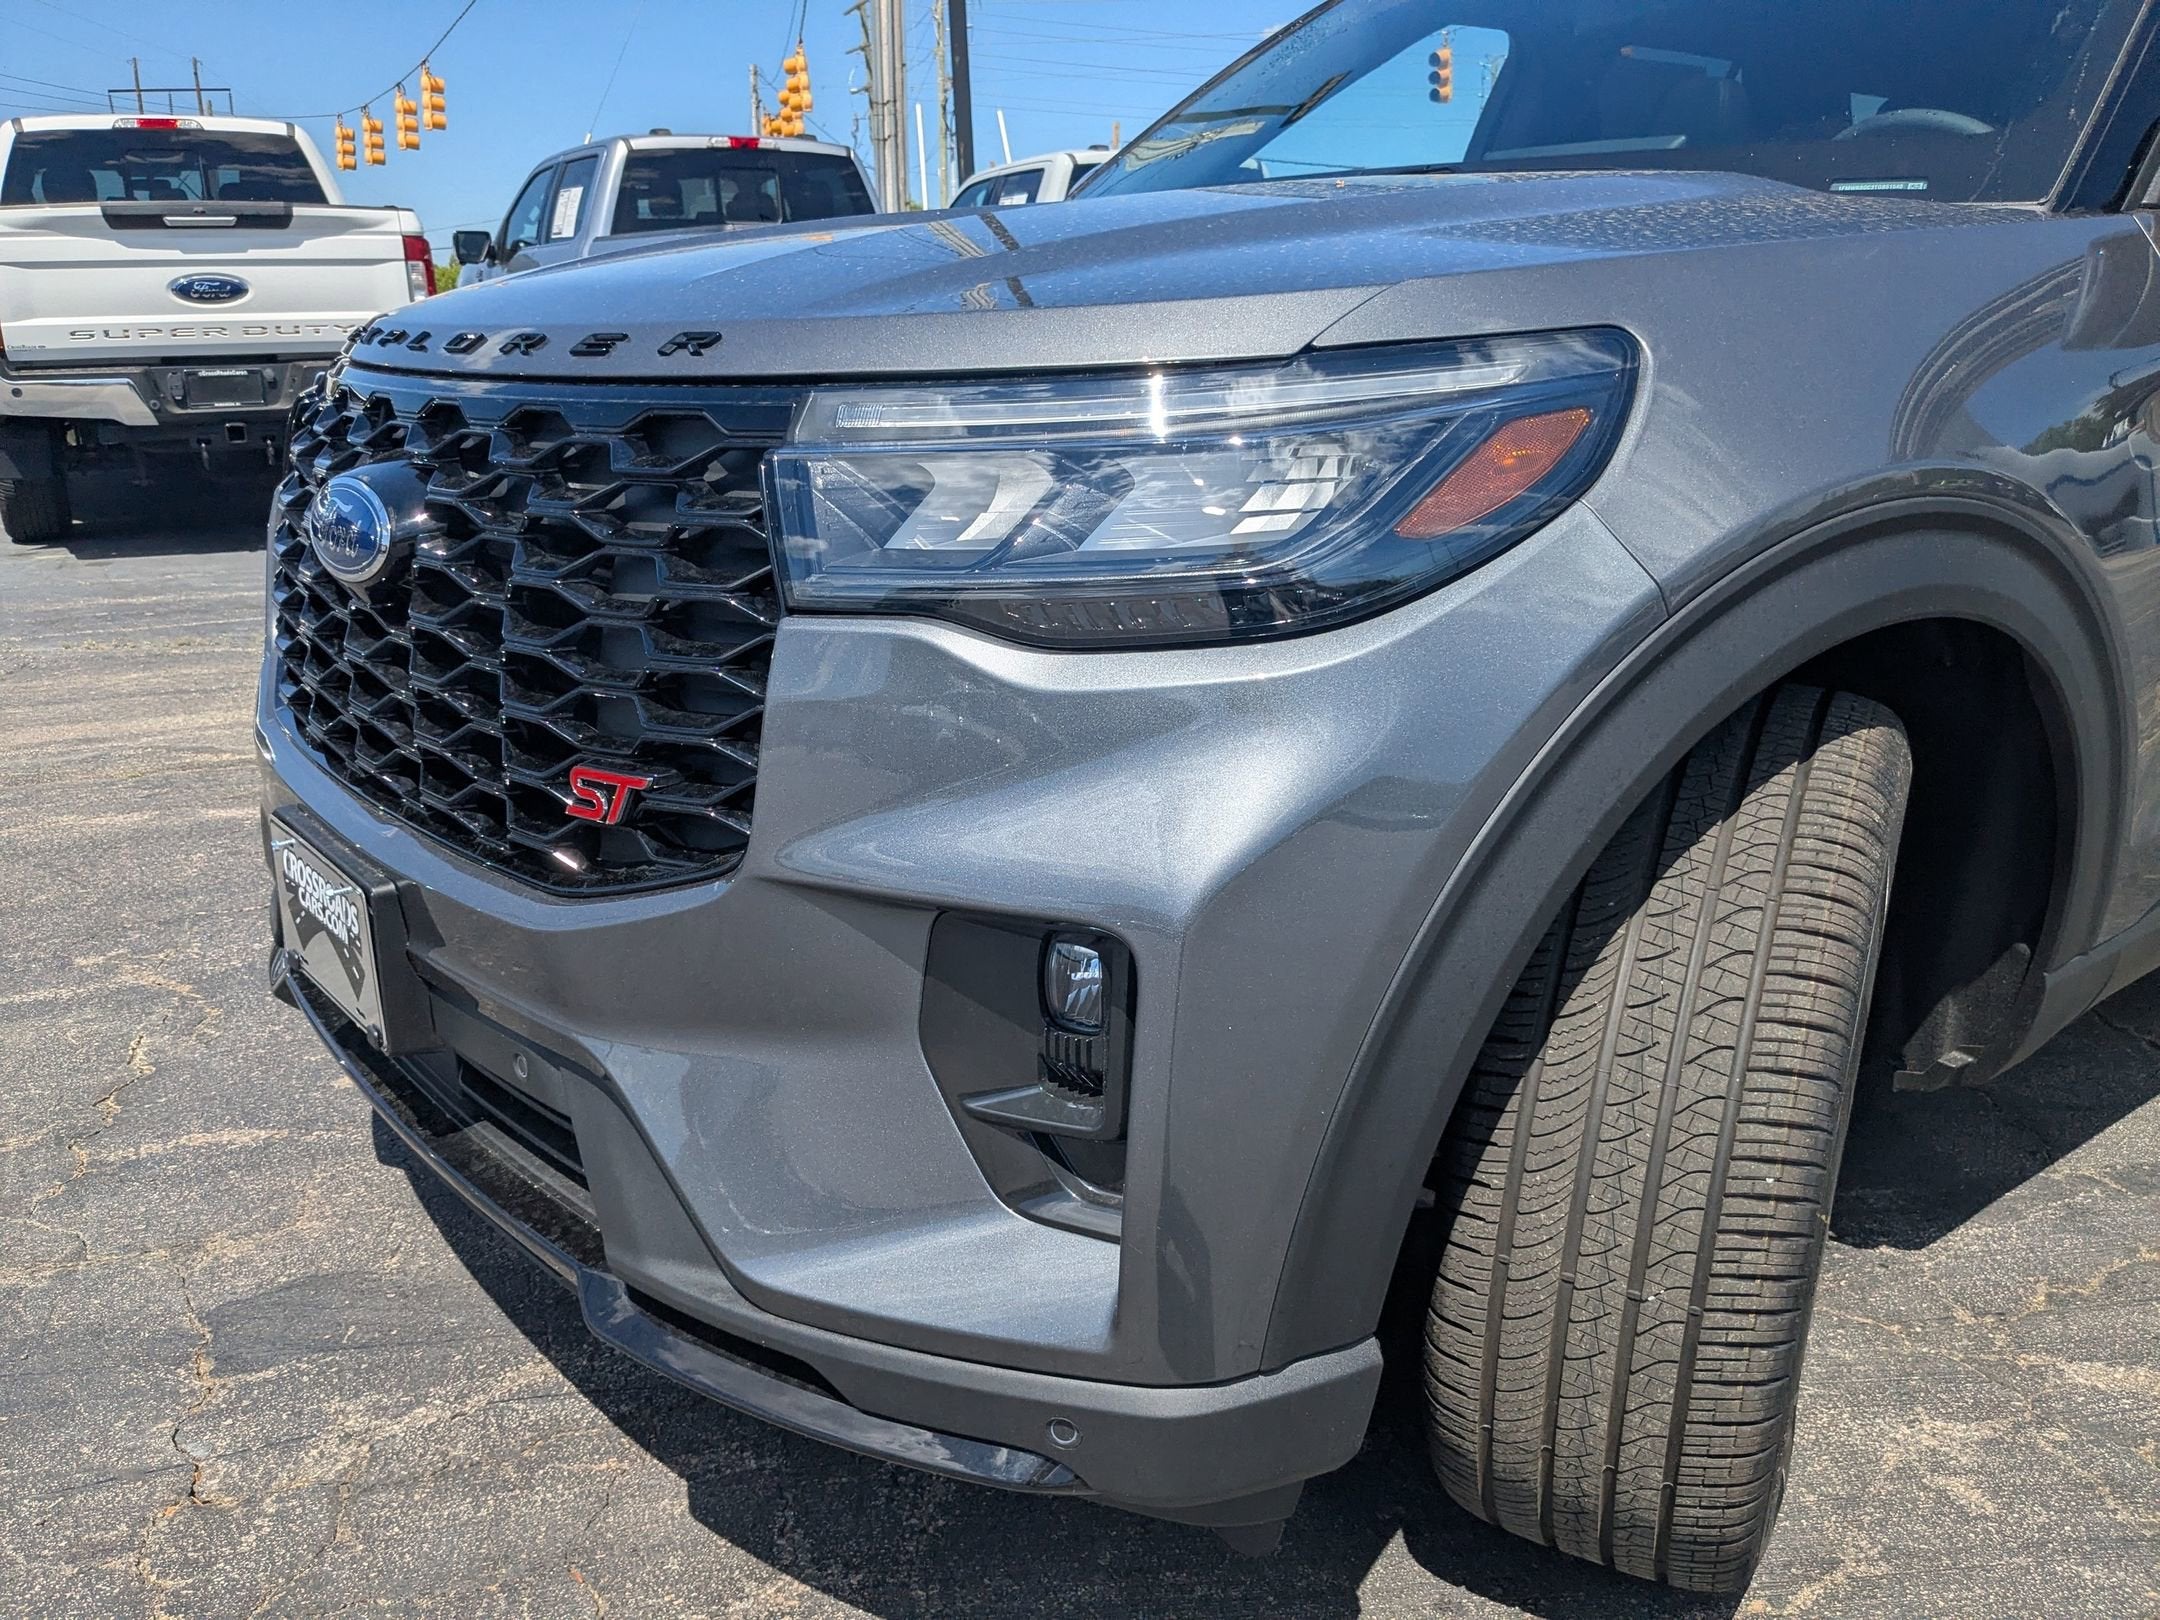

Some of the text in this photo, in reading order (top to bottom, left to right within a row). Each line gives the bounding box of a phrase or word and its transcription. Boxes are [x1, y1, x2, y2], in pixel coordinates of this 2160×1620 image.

[190, 281, 232, 298] Ford
[69, 324, 356, 342] SUPER DUTY
[565, 765, 654, 825] ST
[298, 886, 349, 944] CARS.COM
